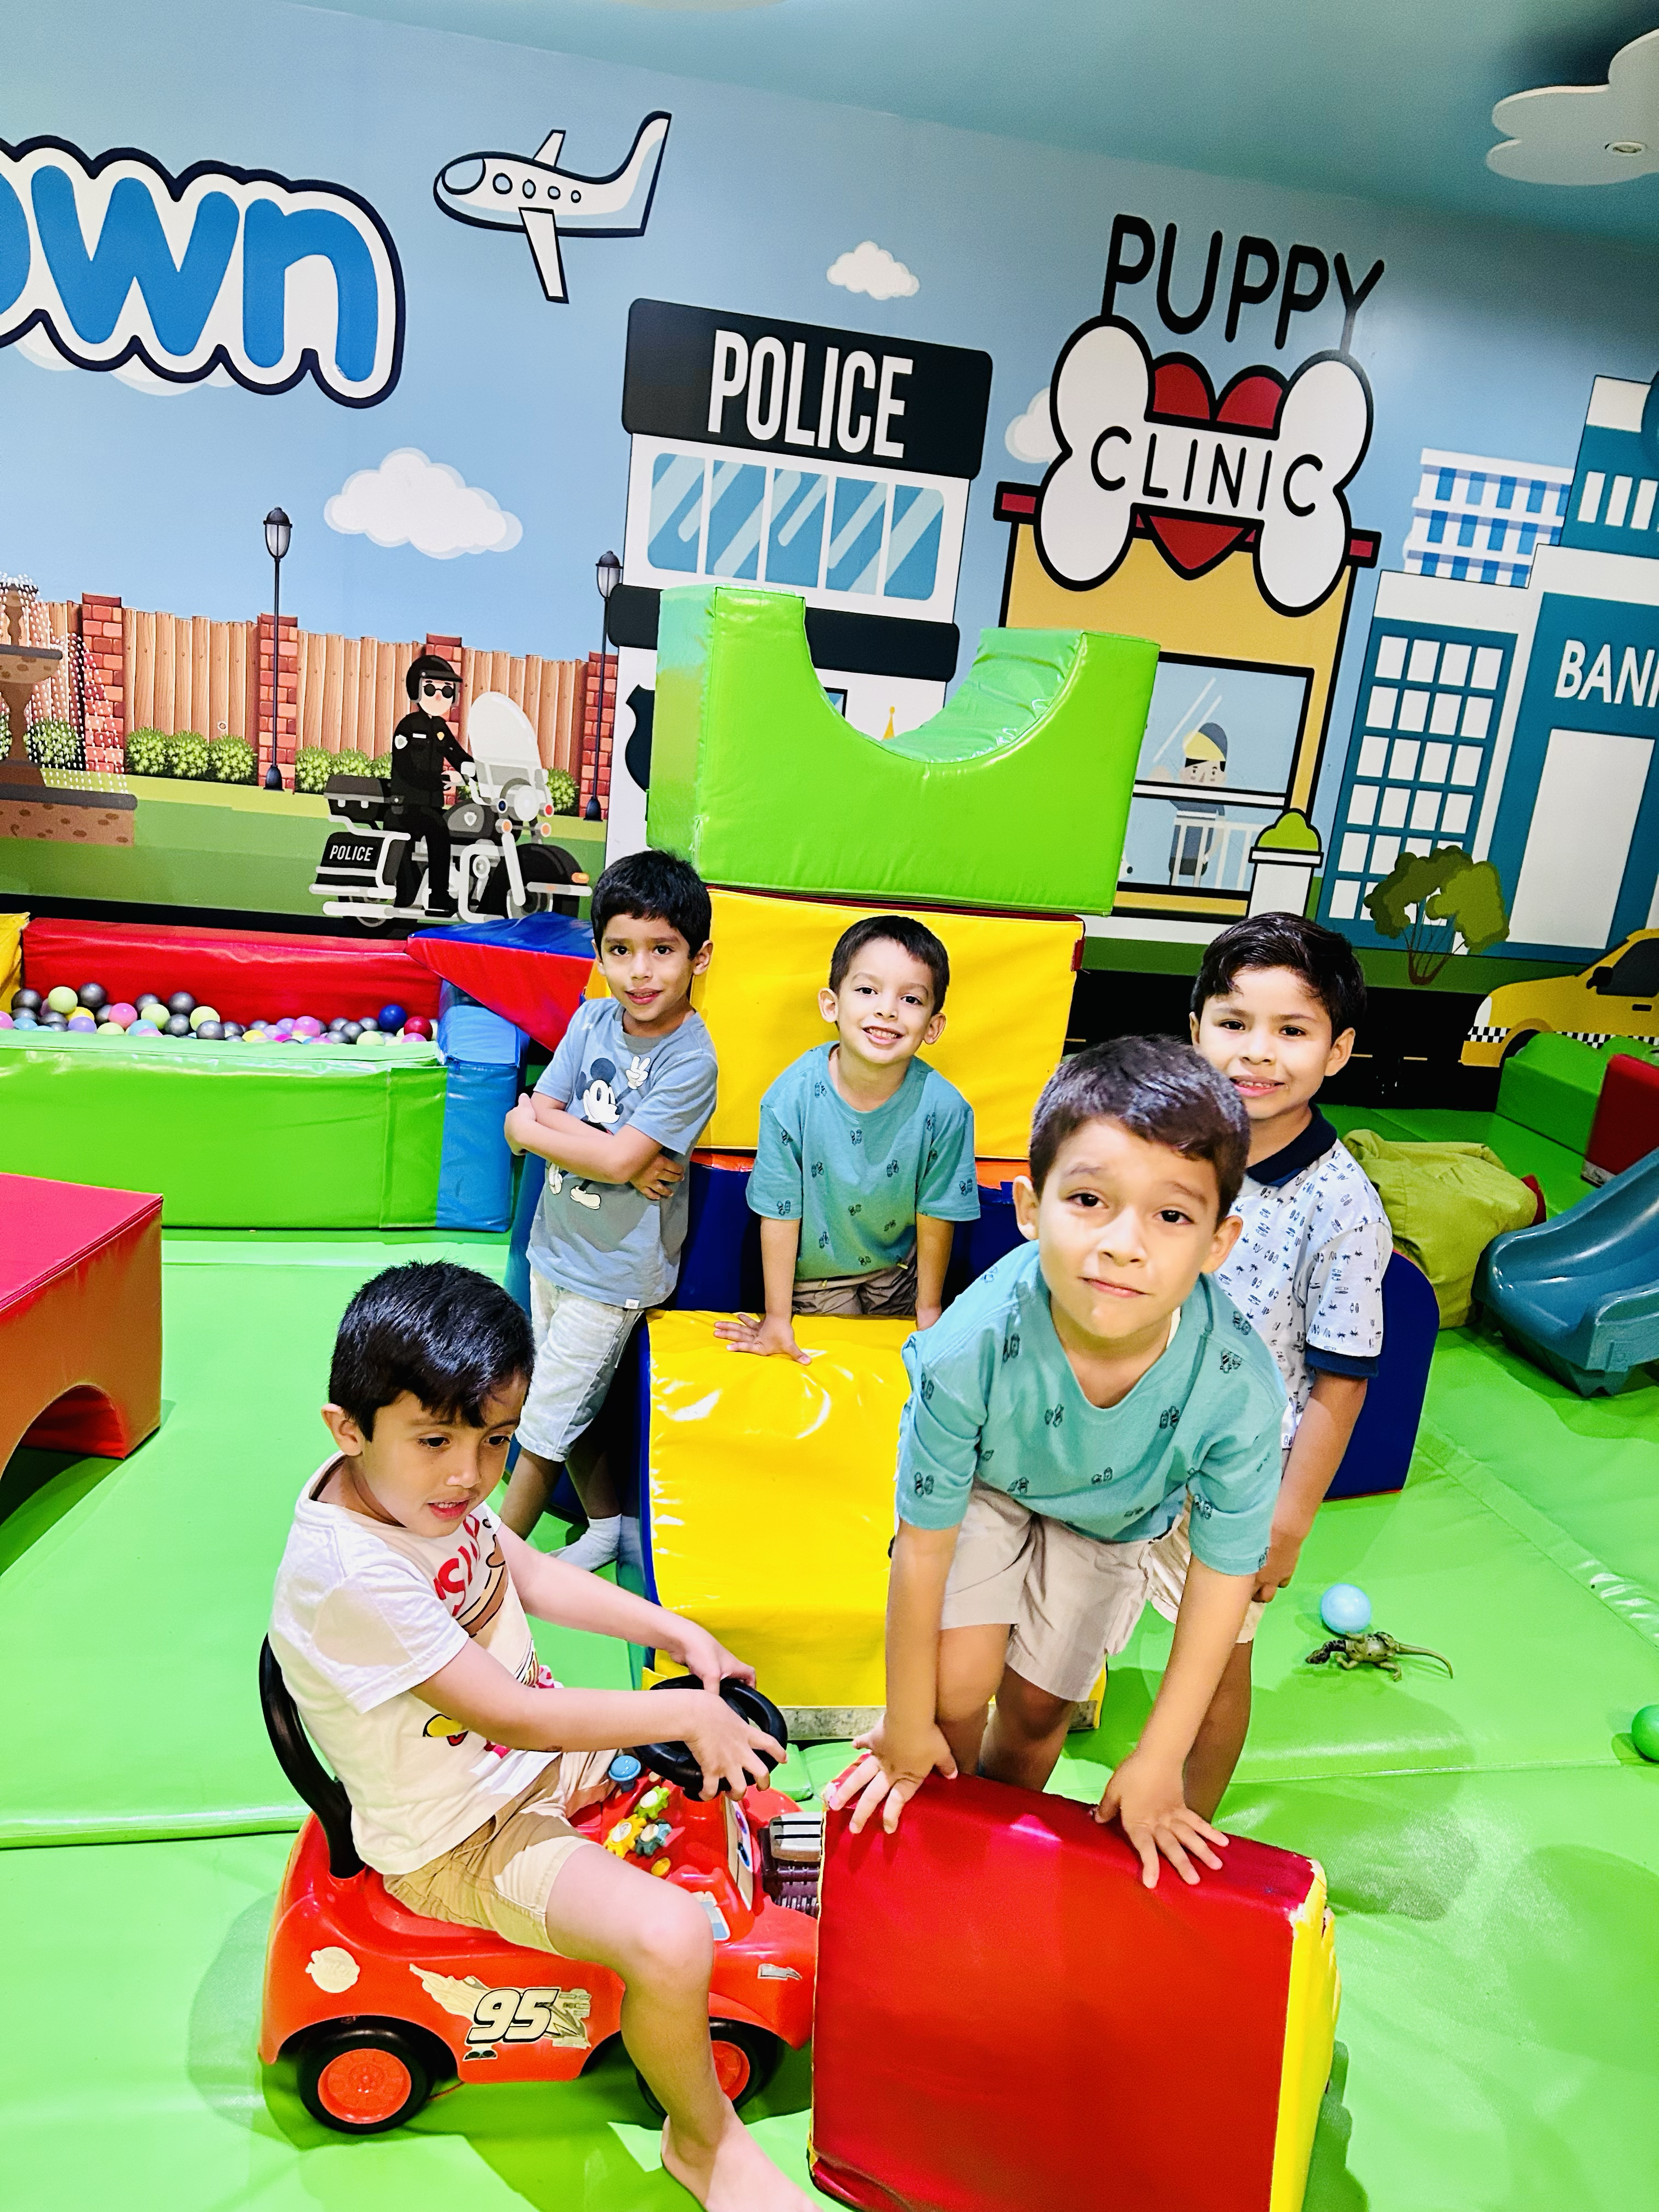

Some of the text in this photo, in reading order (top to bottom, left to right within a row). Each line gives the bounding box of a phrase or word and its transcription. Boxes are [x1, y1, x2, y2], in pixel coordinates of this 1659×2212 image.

[0, 166, 379, 382] wn
[1101, 213, 1385, 354] PUPPY
[707, 329, 913, 459] POLICE
[1091, 426, 1323, 517] CLINIC
[329, 845, 374, 861] POLICE
[466, 1988, 560, 2044] 95
